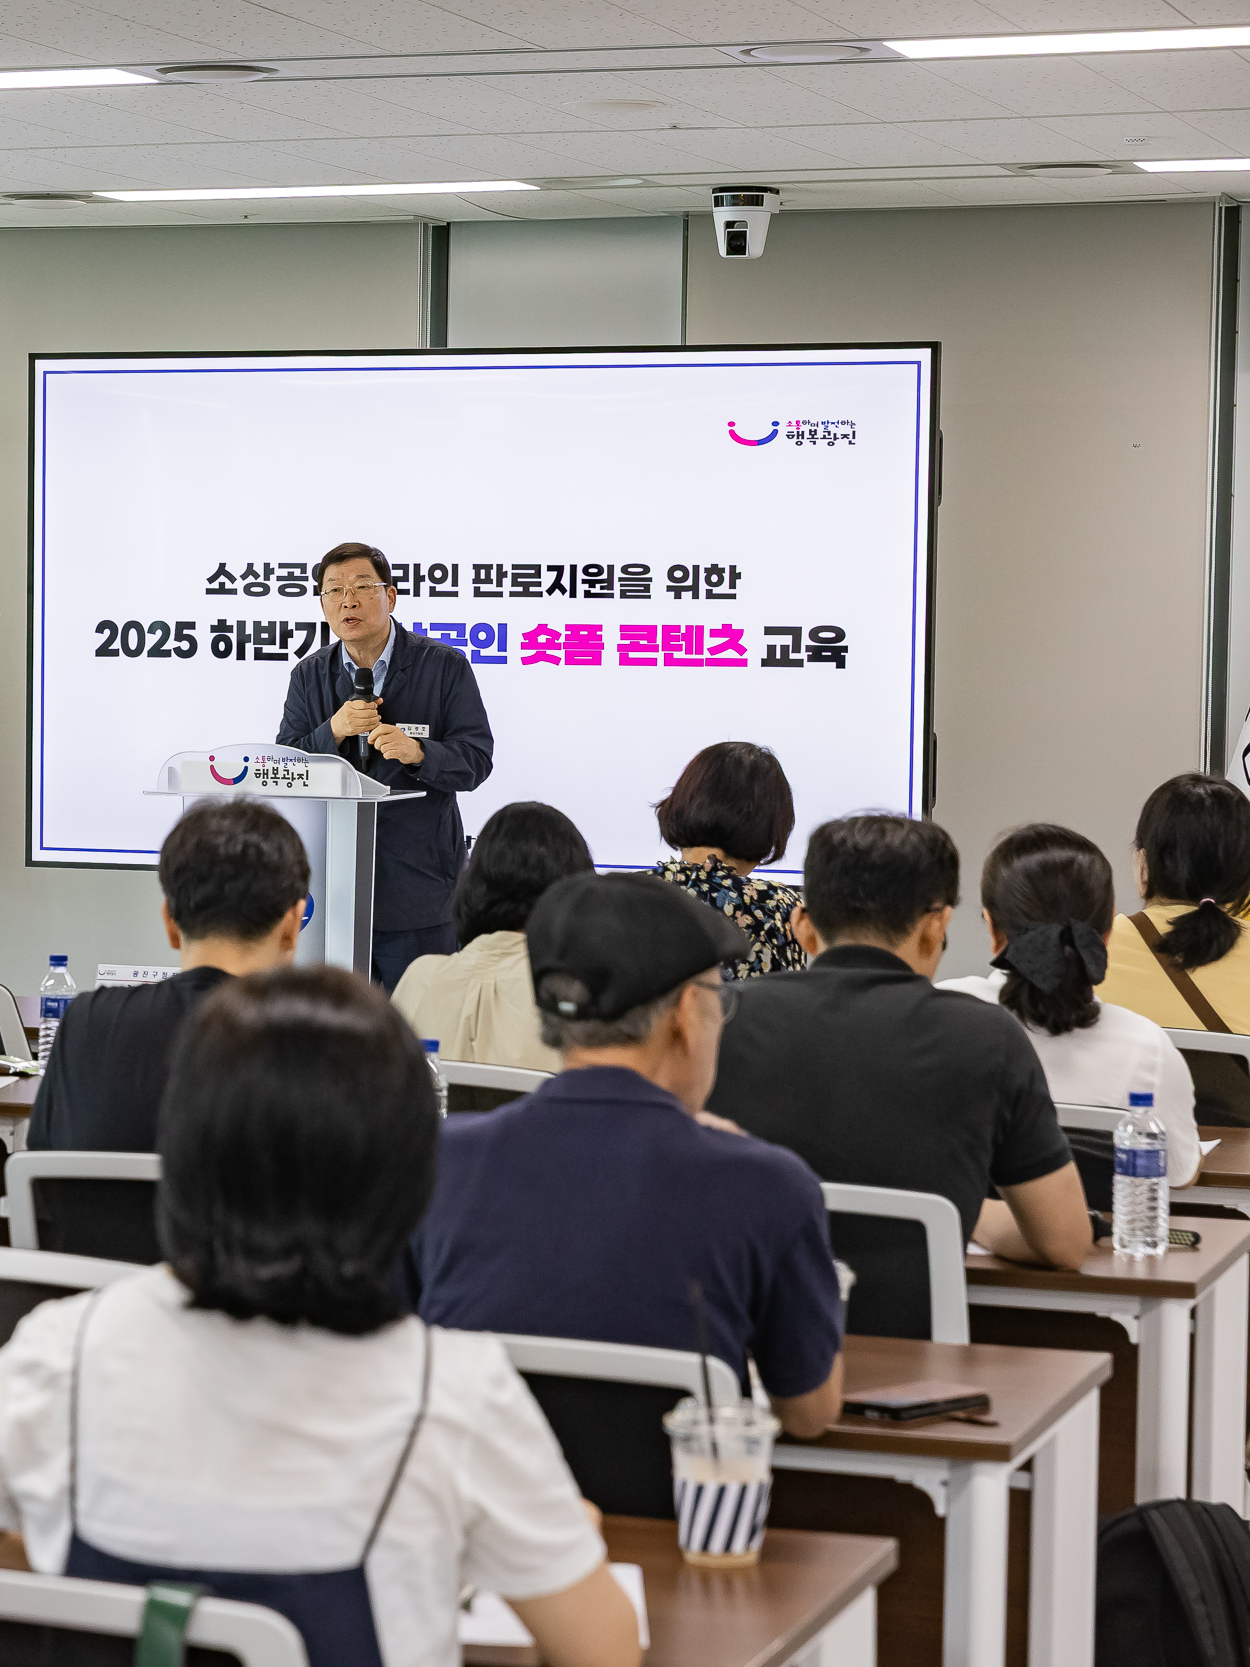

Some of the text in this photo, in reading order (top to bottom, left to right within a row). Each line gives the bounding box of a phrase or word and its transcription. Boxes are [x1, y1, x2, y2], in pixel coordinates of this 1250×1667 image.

[821, 419, 856, 430] 발전하는
[786, 429, 856, 446] 행복광진
[391, 563, 459, 597] 라인
[472, 563, 653, 599] 판로지원을
[666, 563, 742, 600] 위한
[94, 618, 849, 669] 2025 하반기 공인 숏폼 콘텐츠 교육
[281, 756, 309, 768] 발전하는
[253, 766, 309, 788] 행복광진
